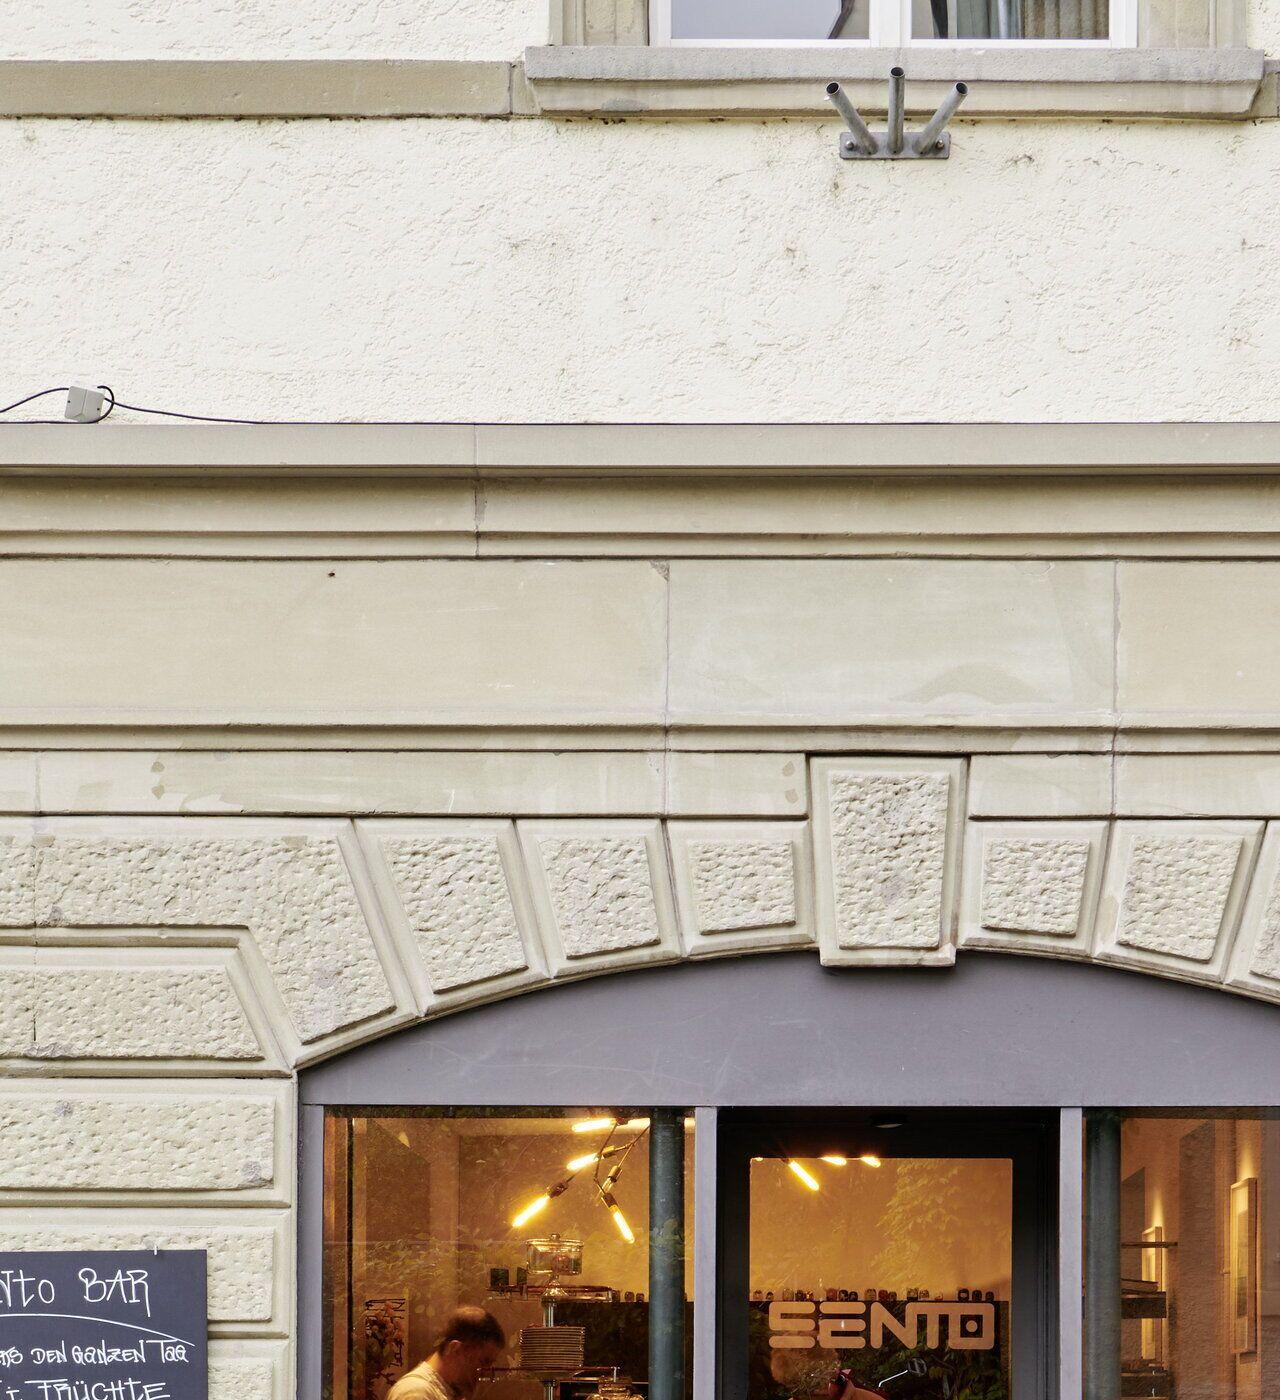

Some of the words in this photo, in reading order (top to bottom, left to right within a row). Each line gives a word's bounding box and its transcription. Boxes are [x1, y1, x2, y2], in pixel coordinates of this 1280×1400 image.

[78, 1267, 151, 1318] BAR
[769, 1302, 994, 1349] SENTO
[30, 1340, 67, 1364] DEN
